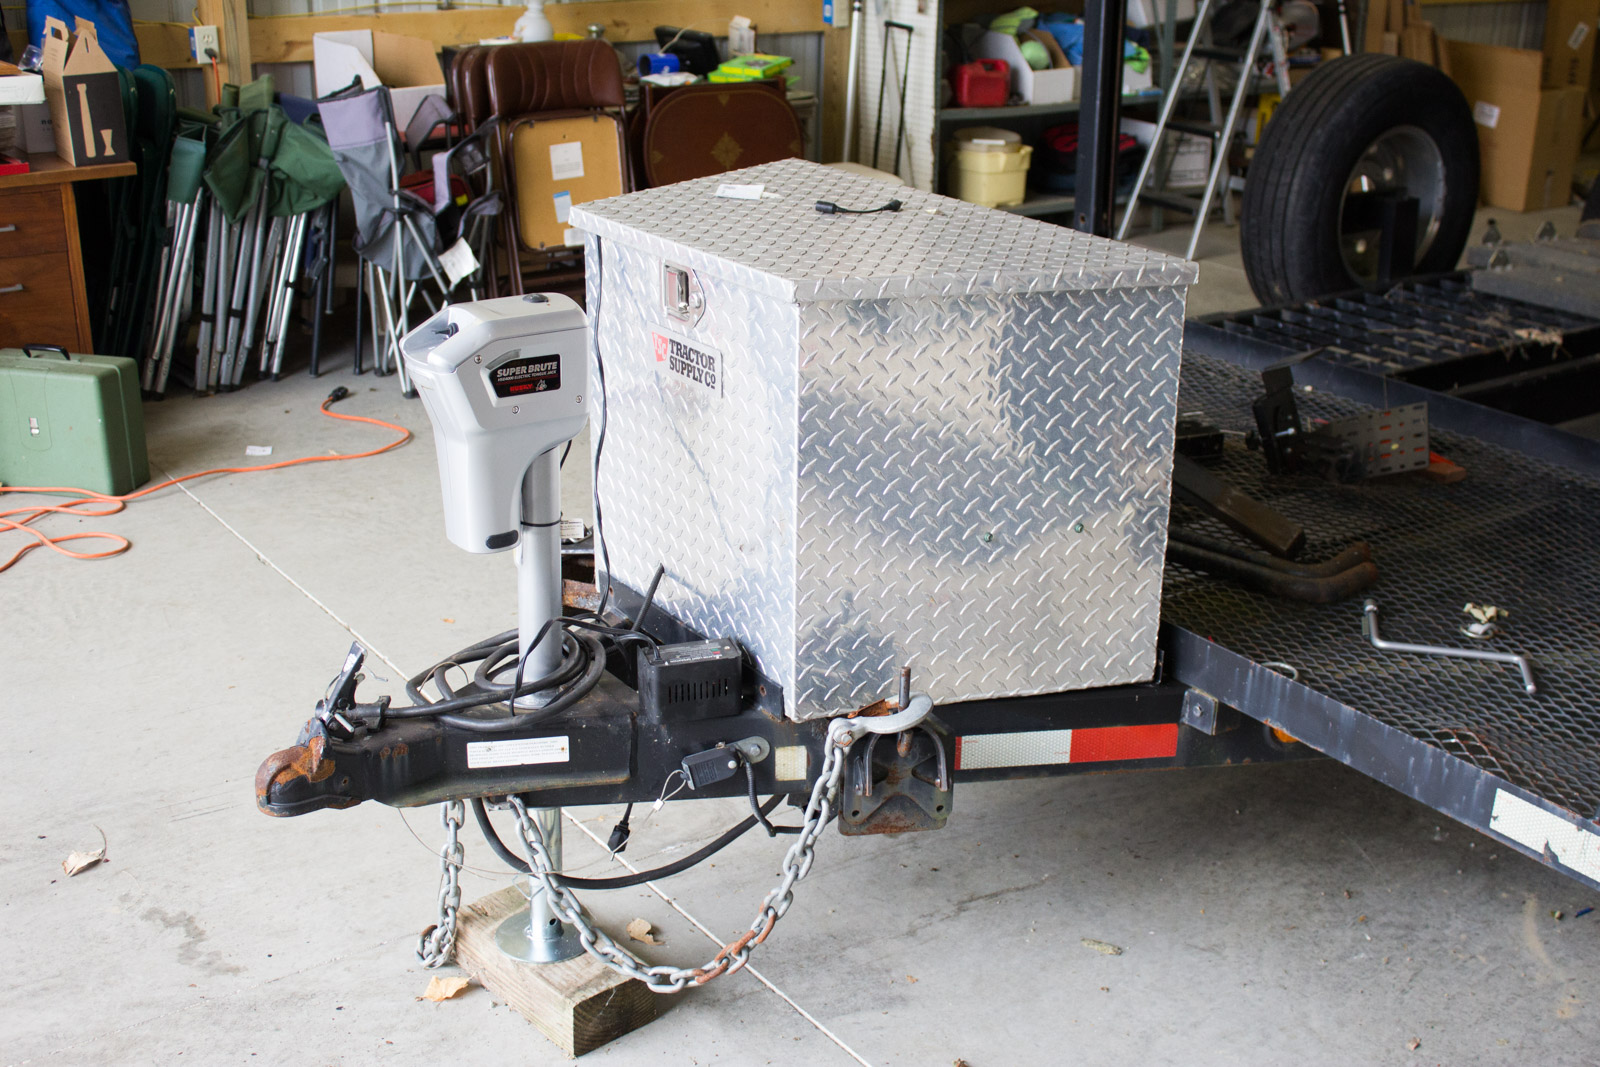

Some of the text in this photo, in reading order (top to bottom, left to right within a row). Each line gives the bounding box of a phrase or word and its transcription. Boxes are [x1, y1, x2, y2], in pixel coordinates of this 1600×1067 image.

[669, 338, 715, 372] TRACTOR
[496, 361, 558, 378] SUPER BRUTE
[669, 355, 704, 384] SUPPLY
[510, 384, 533, 392] HUSKY
